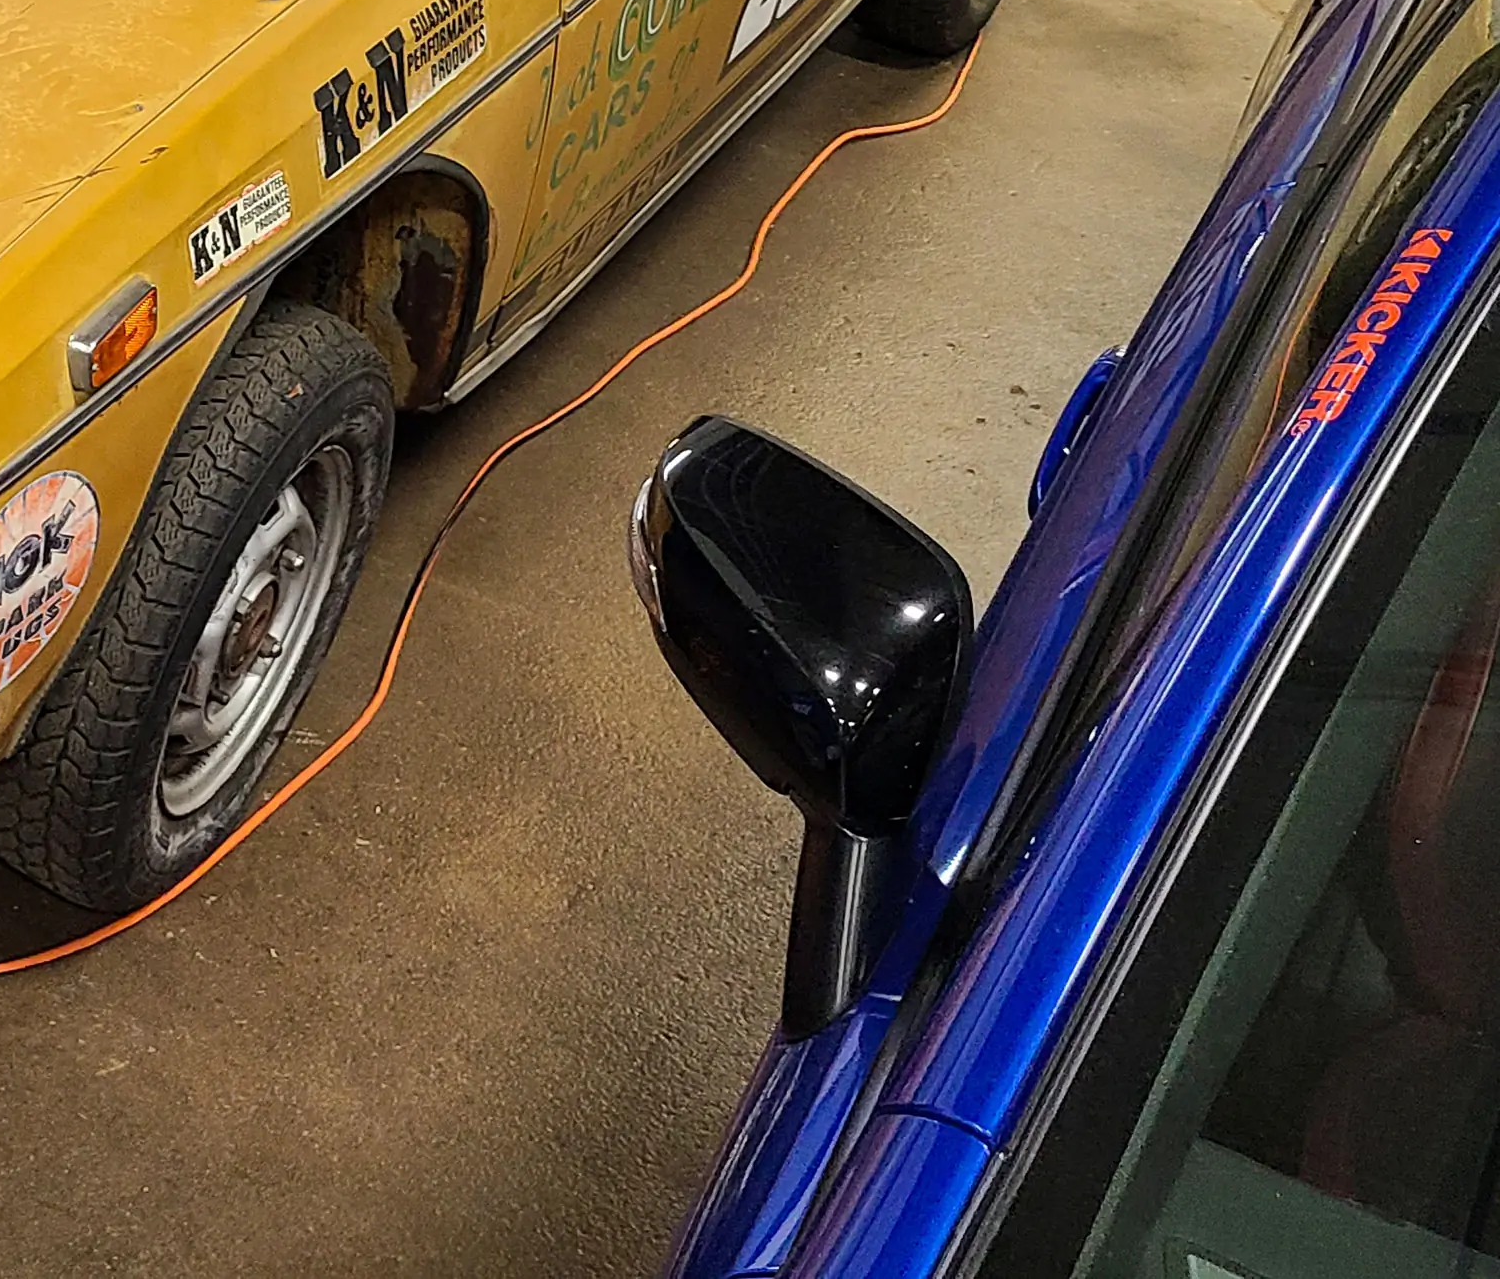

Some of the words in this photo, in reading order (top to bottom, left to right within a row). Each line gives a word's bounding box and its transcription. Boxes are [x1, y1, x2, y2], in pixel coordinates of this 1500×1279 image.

[312, 27, 408, 179] K&N
[430, 24, 486, 87] PRODUCTS
[550, 58, 656, 190] CARS
[190, 203, 241, 280] K&N
